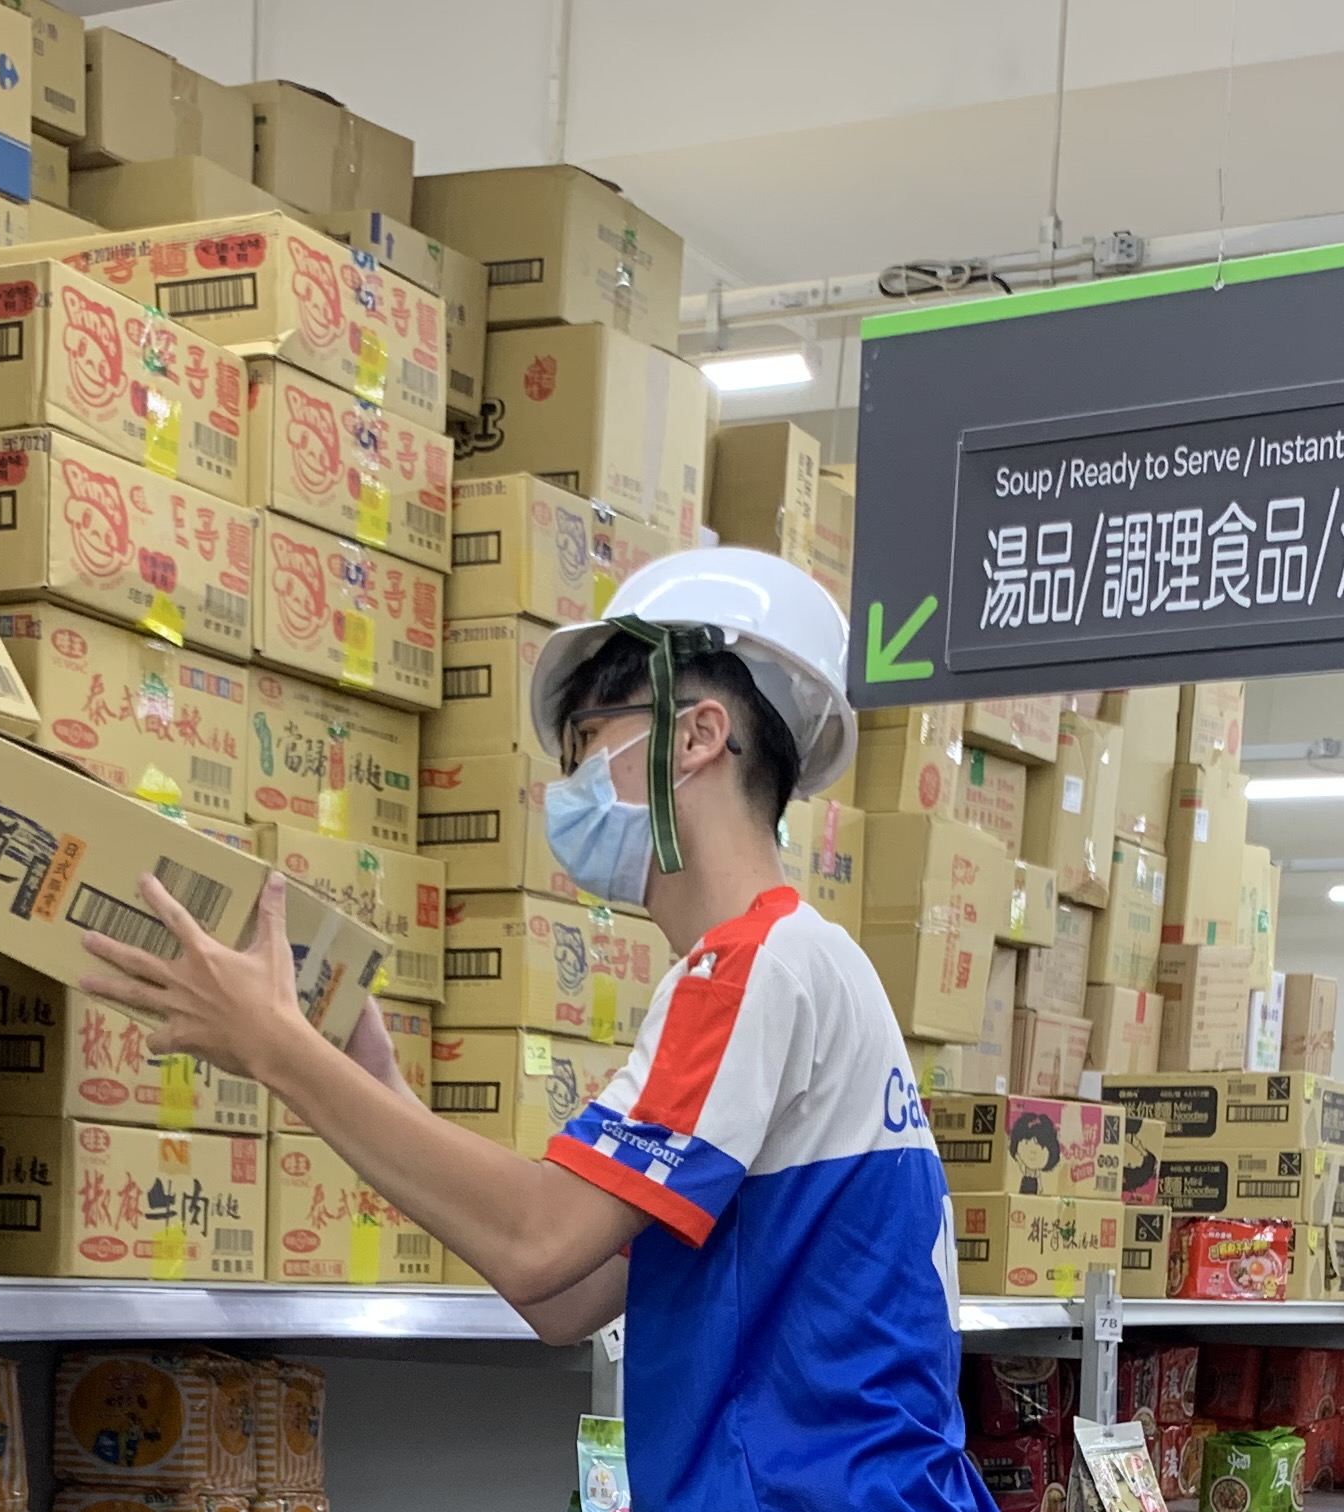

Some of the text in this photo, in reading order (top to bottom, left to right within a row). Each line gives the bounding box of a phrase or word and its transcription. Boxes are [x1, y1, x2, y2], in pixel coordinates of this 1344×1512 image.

[66, 296, 117, 358] Prince
[995, 463, 1052, 502] Soup
[1070, 452, 1140, 494] Ready
[1144, 454, 1168, 482] to
[1172, 447, 1241, 479] Serve
[602, 1118, 685, 1169] Carrefour
[80, 1169, 242, 1238] 椒麻牛肉湯麵
[1099, 1317, 1118, 1330] 78
